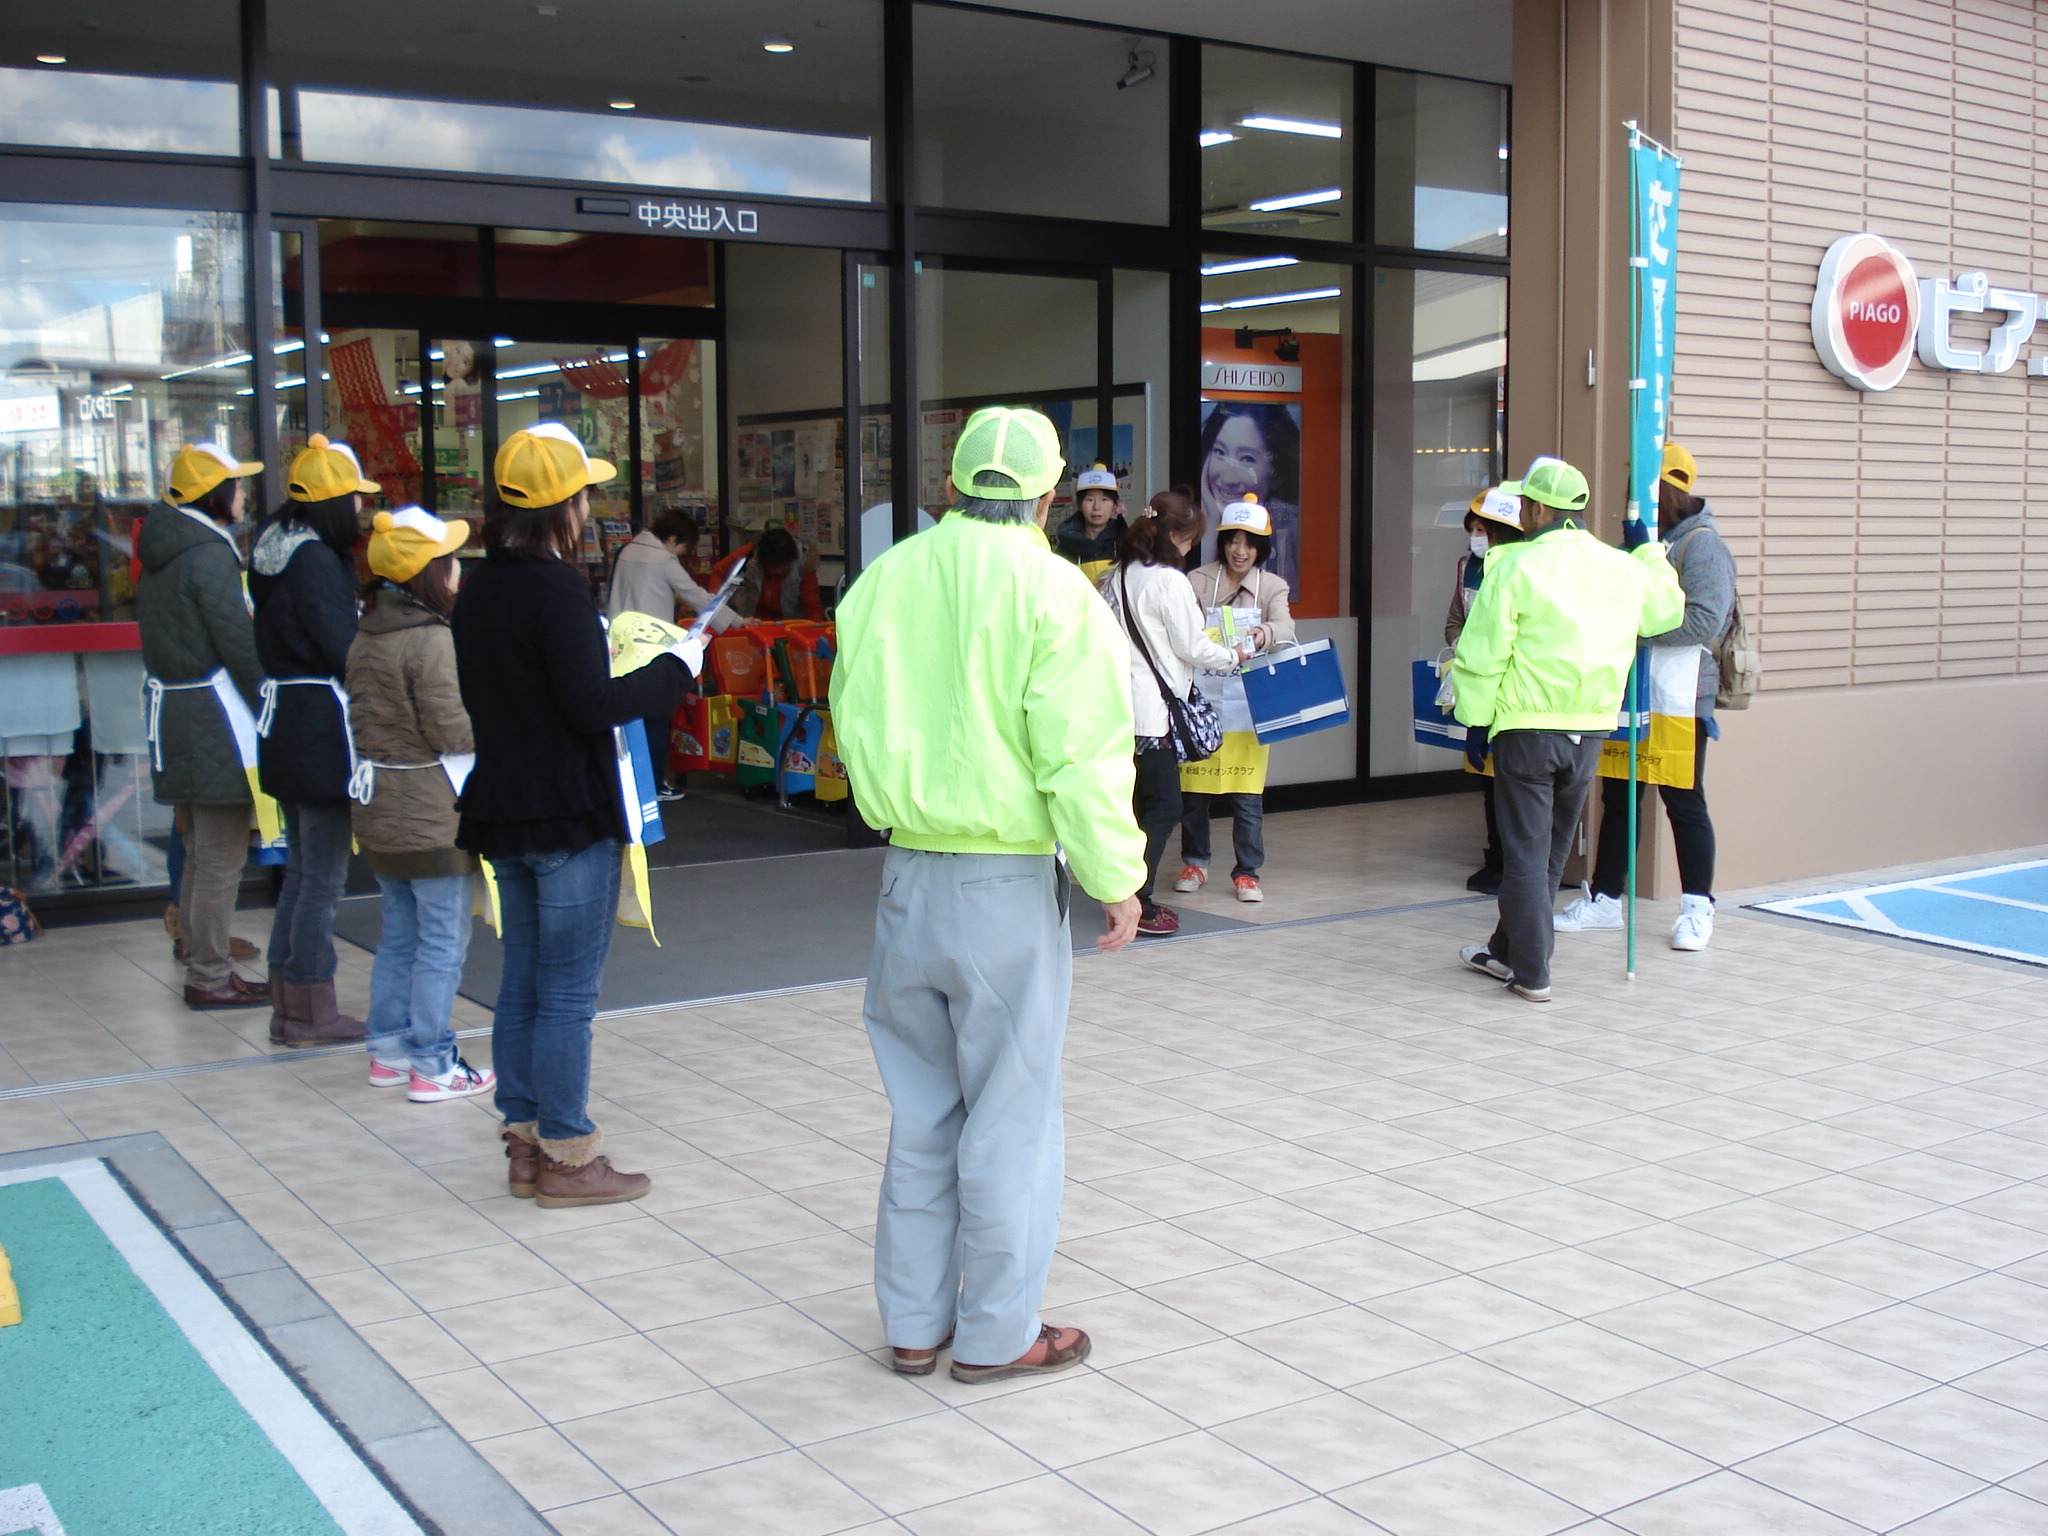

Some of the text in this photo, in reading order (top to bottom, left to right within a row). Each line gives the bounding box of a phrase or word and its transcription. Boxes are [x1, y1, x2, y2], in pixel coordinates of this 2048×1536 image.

[638, 201, 758, 233] 中央出入口
[1849, 301, 1901, 324] PIAGO
[1918, 272, 2048, 376] ピア
[1208, 366, 1286, 387] SHISEIDO
